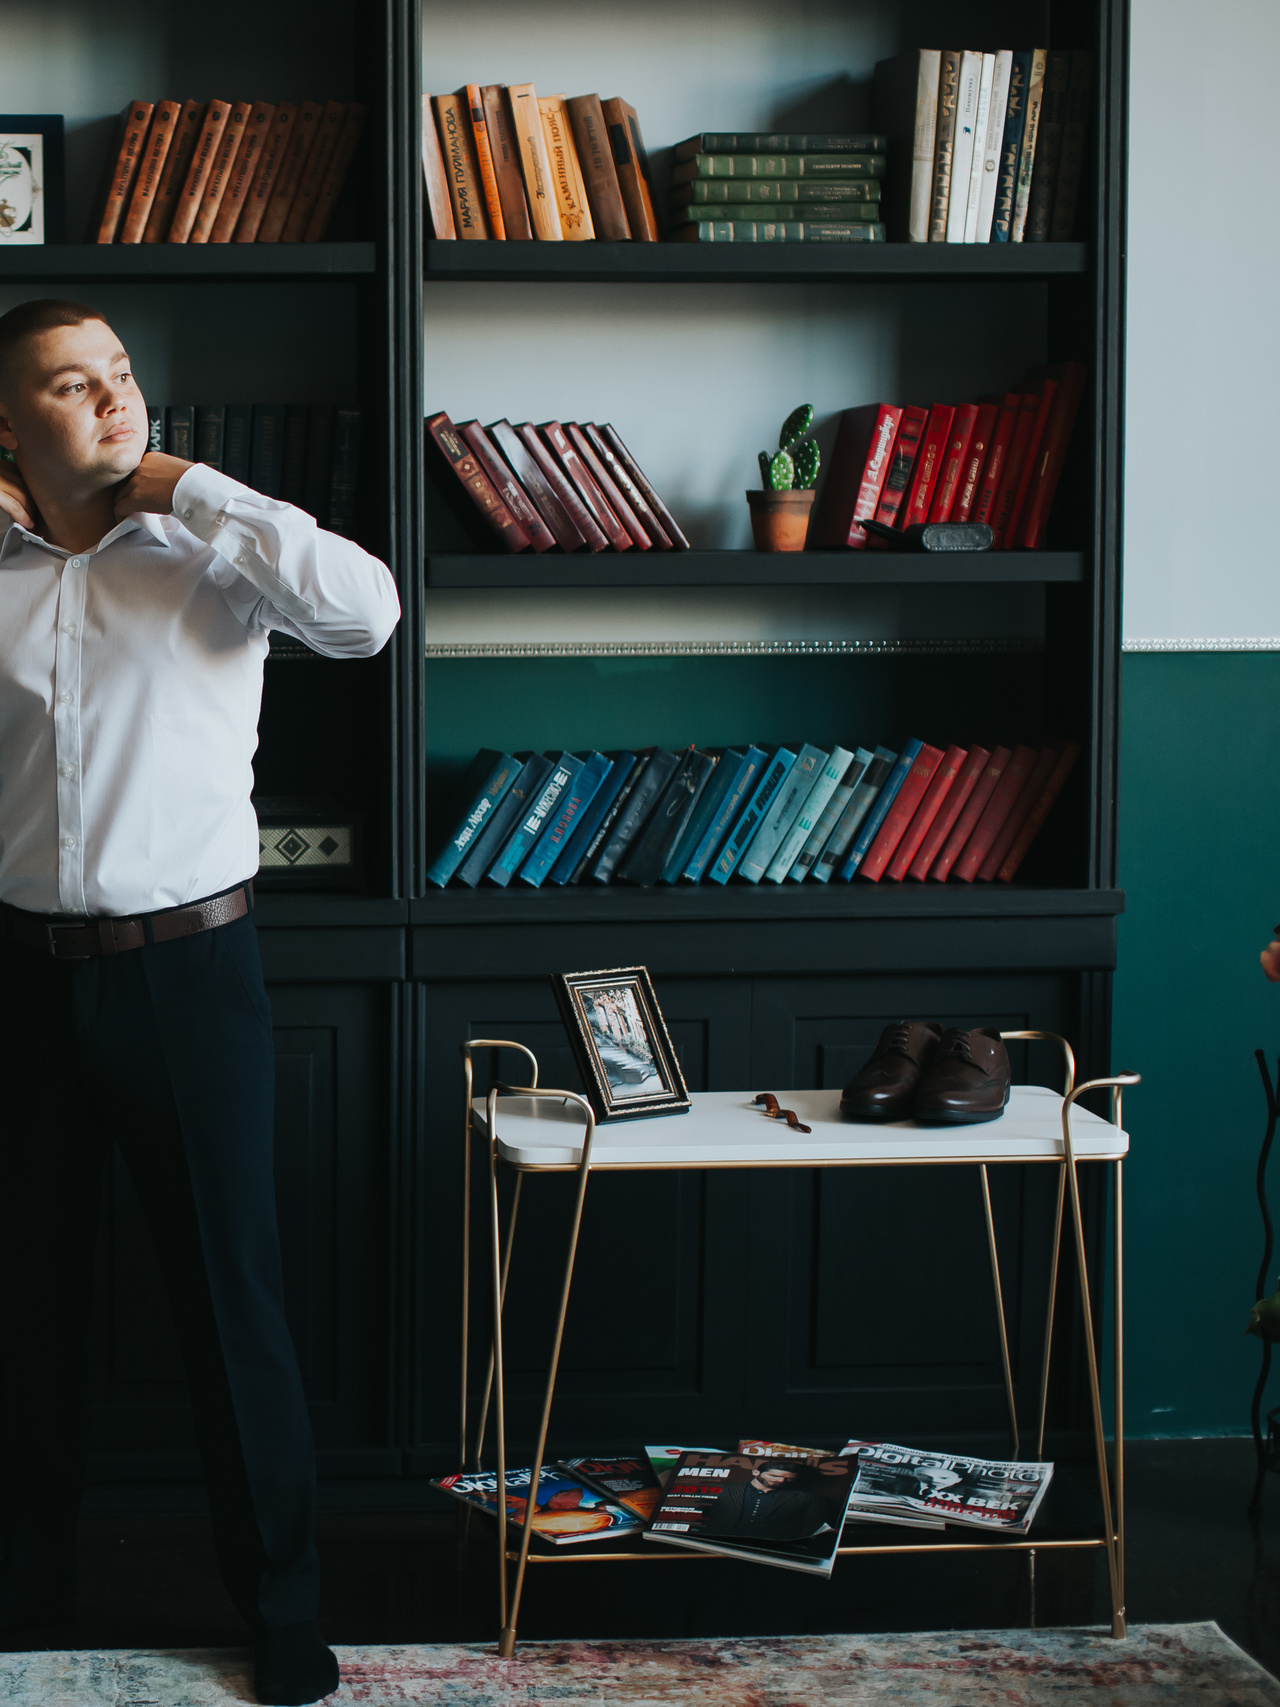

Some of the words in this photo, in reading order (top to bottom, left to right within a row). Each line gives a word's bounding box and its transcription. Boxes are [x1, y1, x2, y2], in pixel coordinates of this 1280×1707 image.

[965, 78, 974, 113] Почемучка
[553, 145, 578, 210] КАМЕННЫЙ
[457, 185, 473, 228] МАРИЯ
[677, 1467, 731, 1478] MEN
[856, 1447, 1041, 1482] DigitalPhoto
[670, 1485, 723, 1495] 2019
[965, 1497, 1022, 1511] ВЕК
